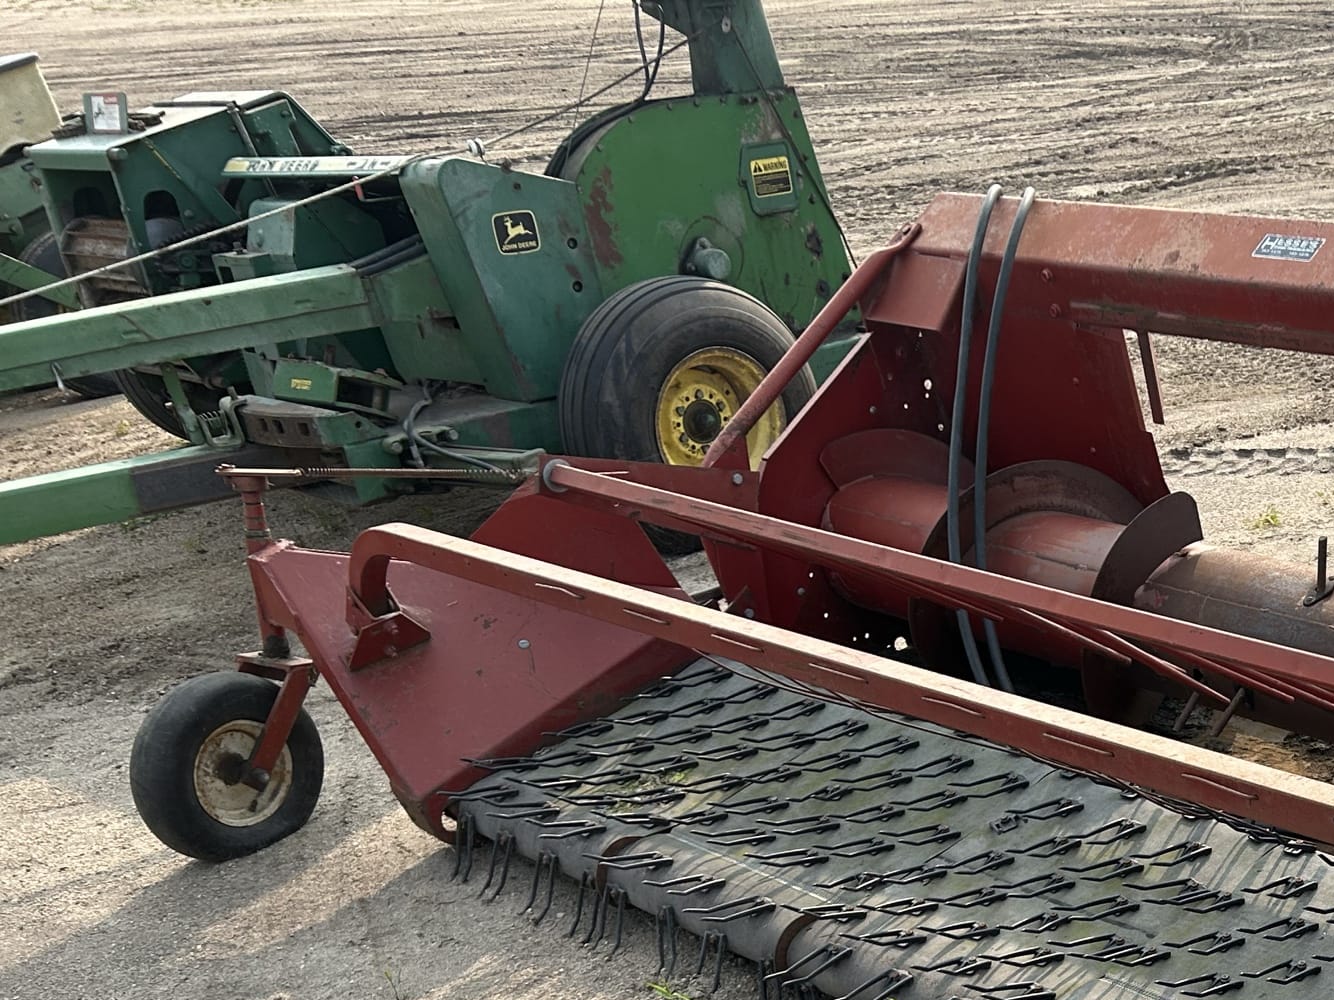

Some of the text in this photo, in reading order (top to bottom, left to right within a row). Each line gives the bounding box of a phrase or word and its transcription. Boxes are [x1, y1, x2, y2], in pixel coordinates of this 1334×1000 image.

[762, 160, 787, 171] WARNING
[501, 240, 537, 251] JOHN DEERE
